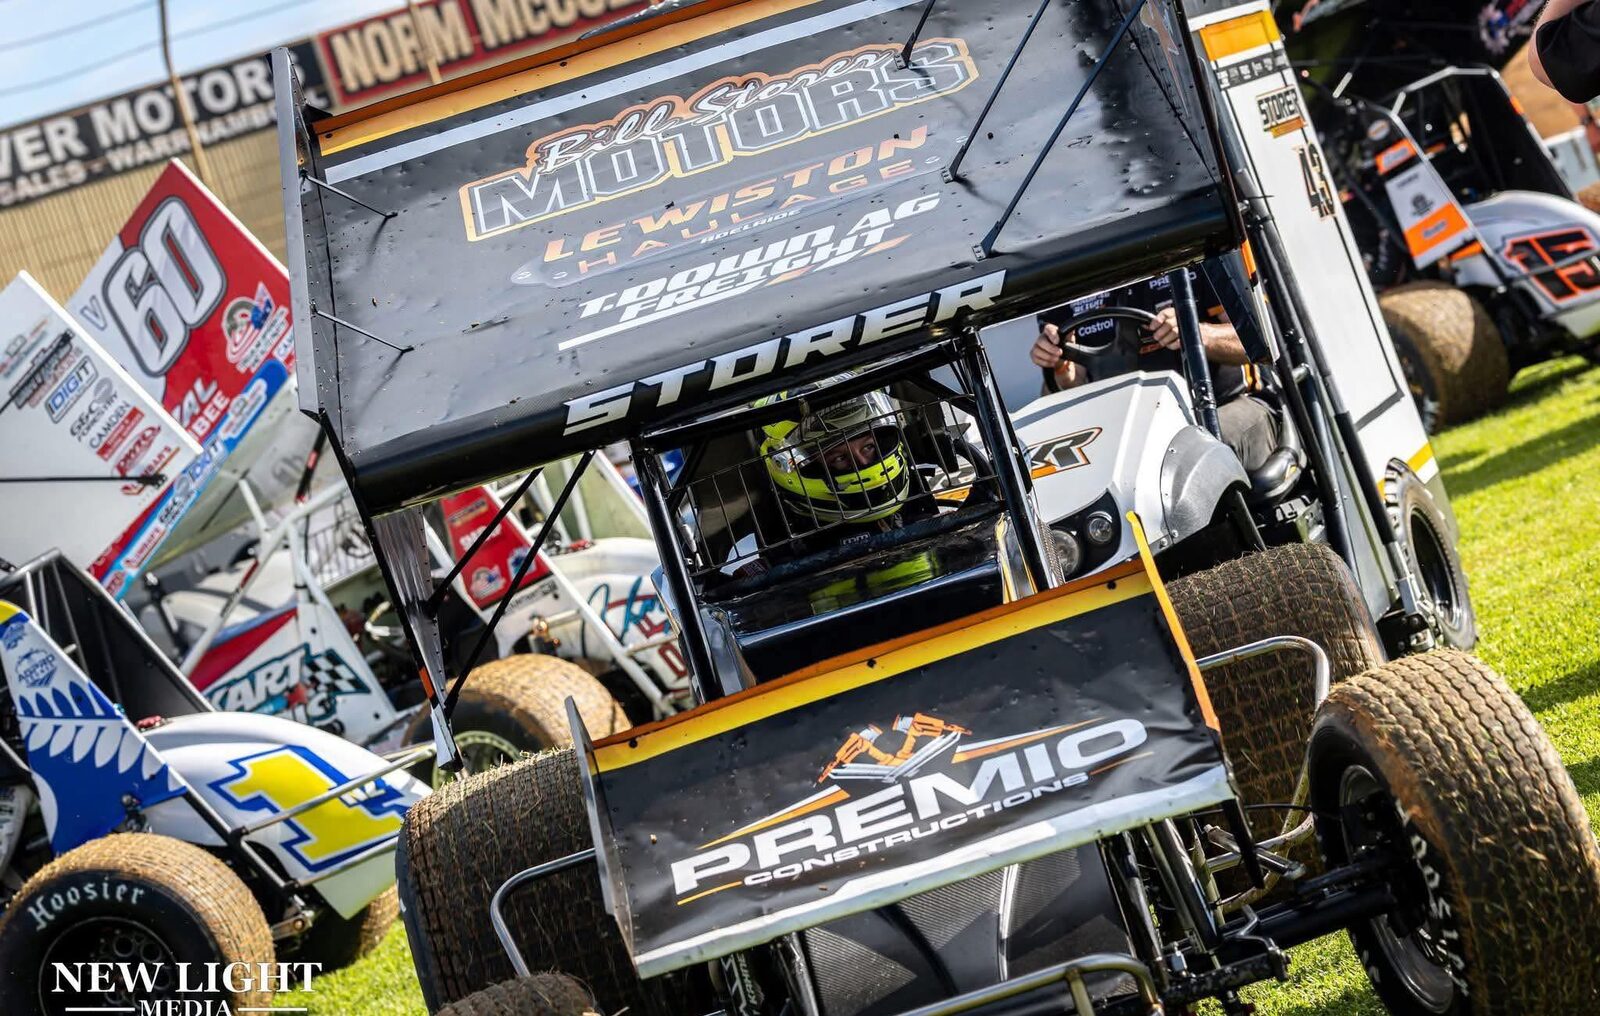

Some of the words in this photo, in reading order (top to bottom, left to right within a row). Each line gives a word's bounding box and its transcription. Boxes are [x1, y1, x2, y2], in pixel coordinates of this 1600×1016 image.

[330, 4, 474, 94] NORM
[468, 42, 970, 237] MOTORS
[536, 103, 680, 175] Bill
[689, 49, 897, 126] Storer
[543, 125, 928, 263] LEWISTON
[578, 158, 917, 275] HAULAGE
[700, 208, 802, 244] ADELAIDE
[849, 192, 941, 234] AG
[101, 195, 227, 378] 60
[620, 223, 895, 322] FREIGHT
[563, 269, 1006, 436] STORER
[1078, 318, 1114, 338] Castrol
[48, 361, 89, 414] IDIGIT
[89, 401, 132, 449] CAMDEN
[171, 377, 218, 428] AL
[186, 390, 231, 441] BEE
[670, 718, 1149, 897] PREMIO
[743, 771, 1090, 887] CONSTRUCTIONS
[27, 875, 145, 932] Hoosier
